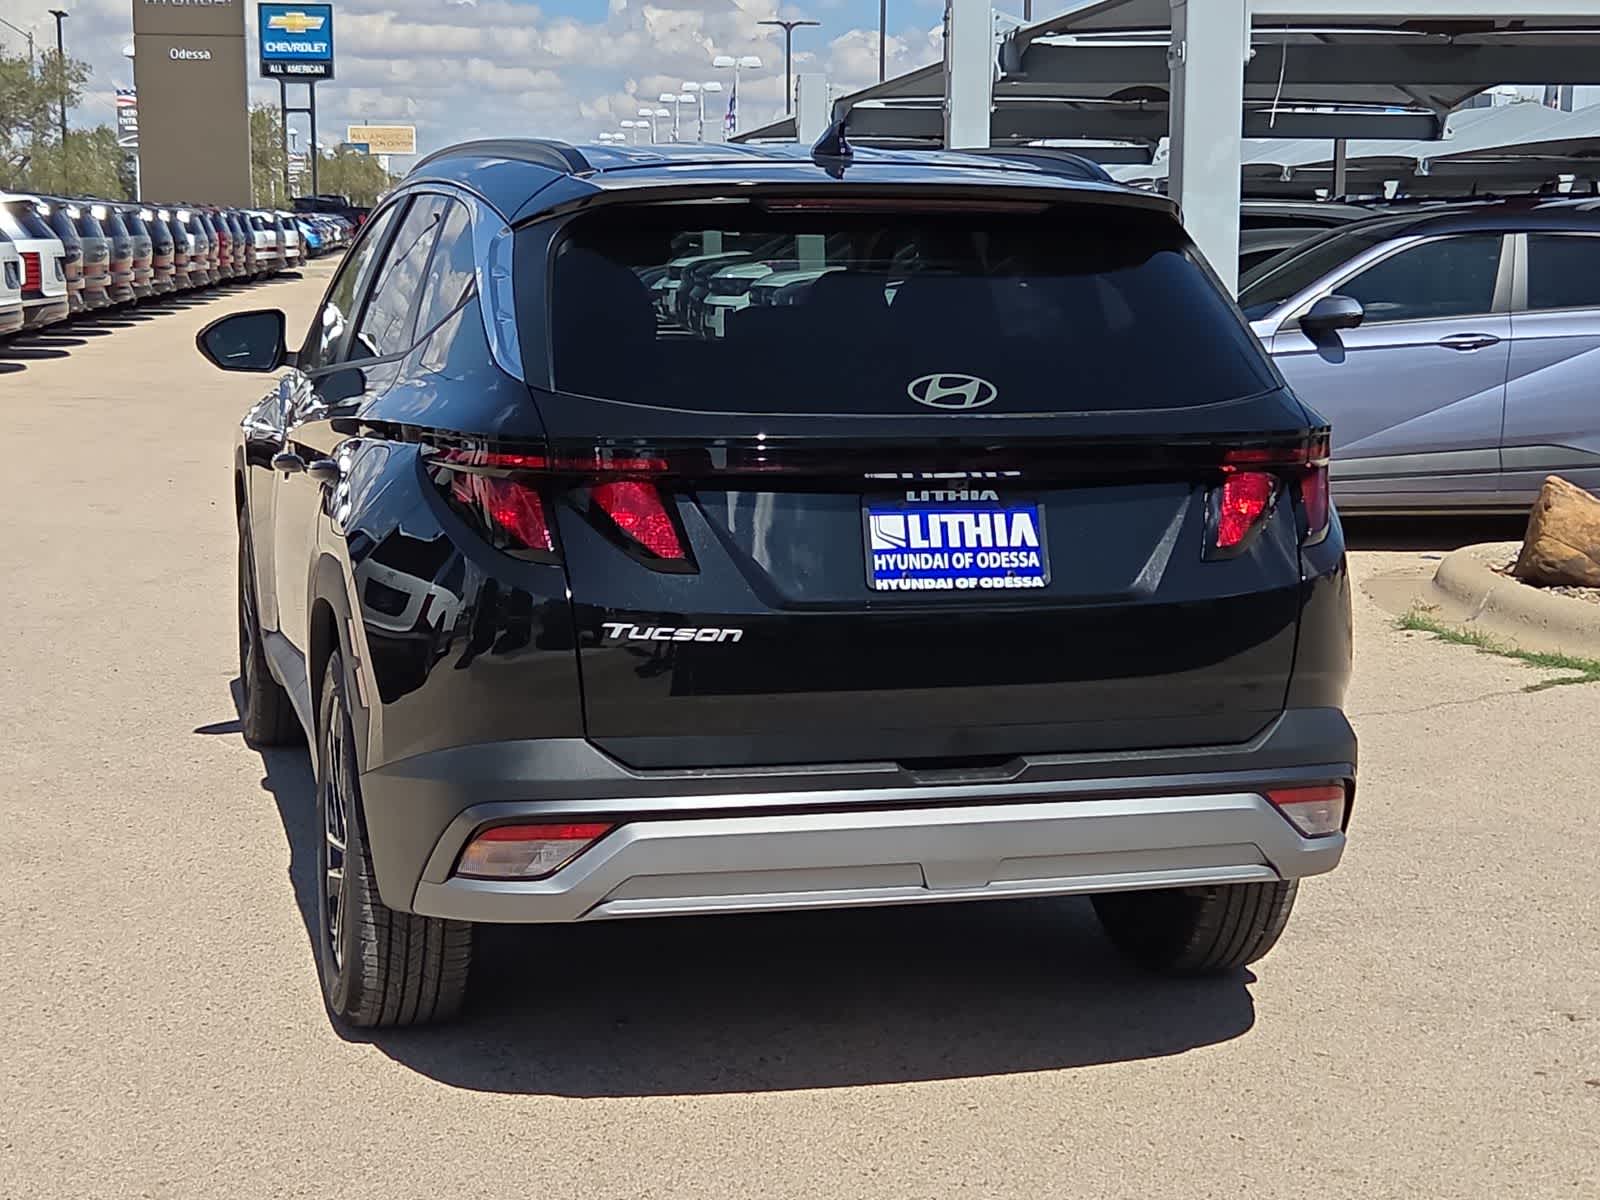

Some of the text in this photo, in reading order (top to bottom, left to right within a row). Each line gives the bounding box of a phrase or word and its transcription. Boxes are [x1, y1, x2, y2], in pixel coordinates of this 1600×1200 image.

[169, 47, 212, 60] Odessa
[265, 42, 328, 53] CHEVROLET
[270, 64, 325, 74] ALL AMERICAN
[906, 490, 999, 502] LITHIA
[907, 513, 1039, 549] LITHIA
[873, 551, 1040, 571] HYUNDAI OF ODESSA
[876, 575, 1045, 591] HYUNDAI OF ODESSA
